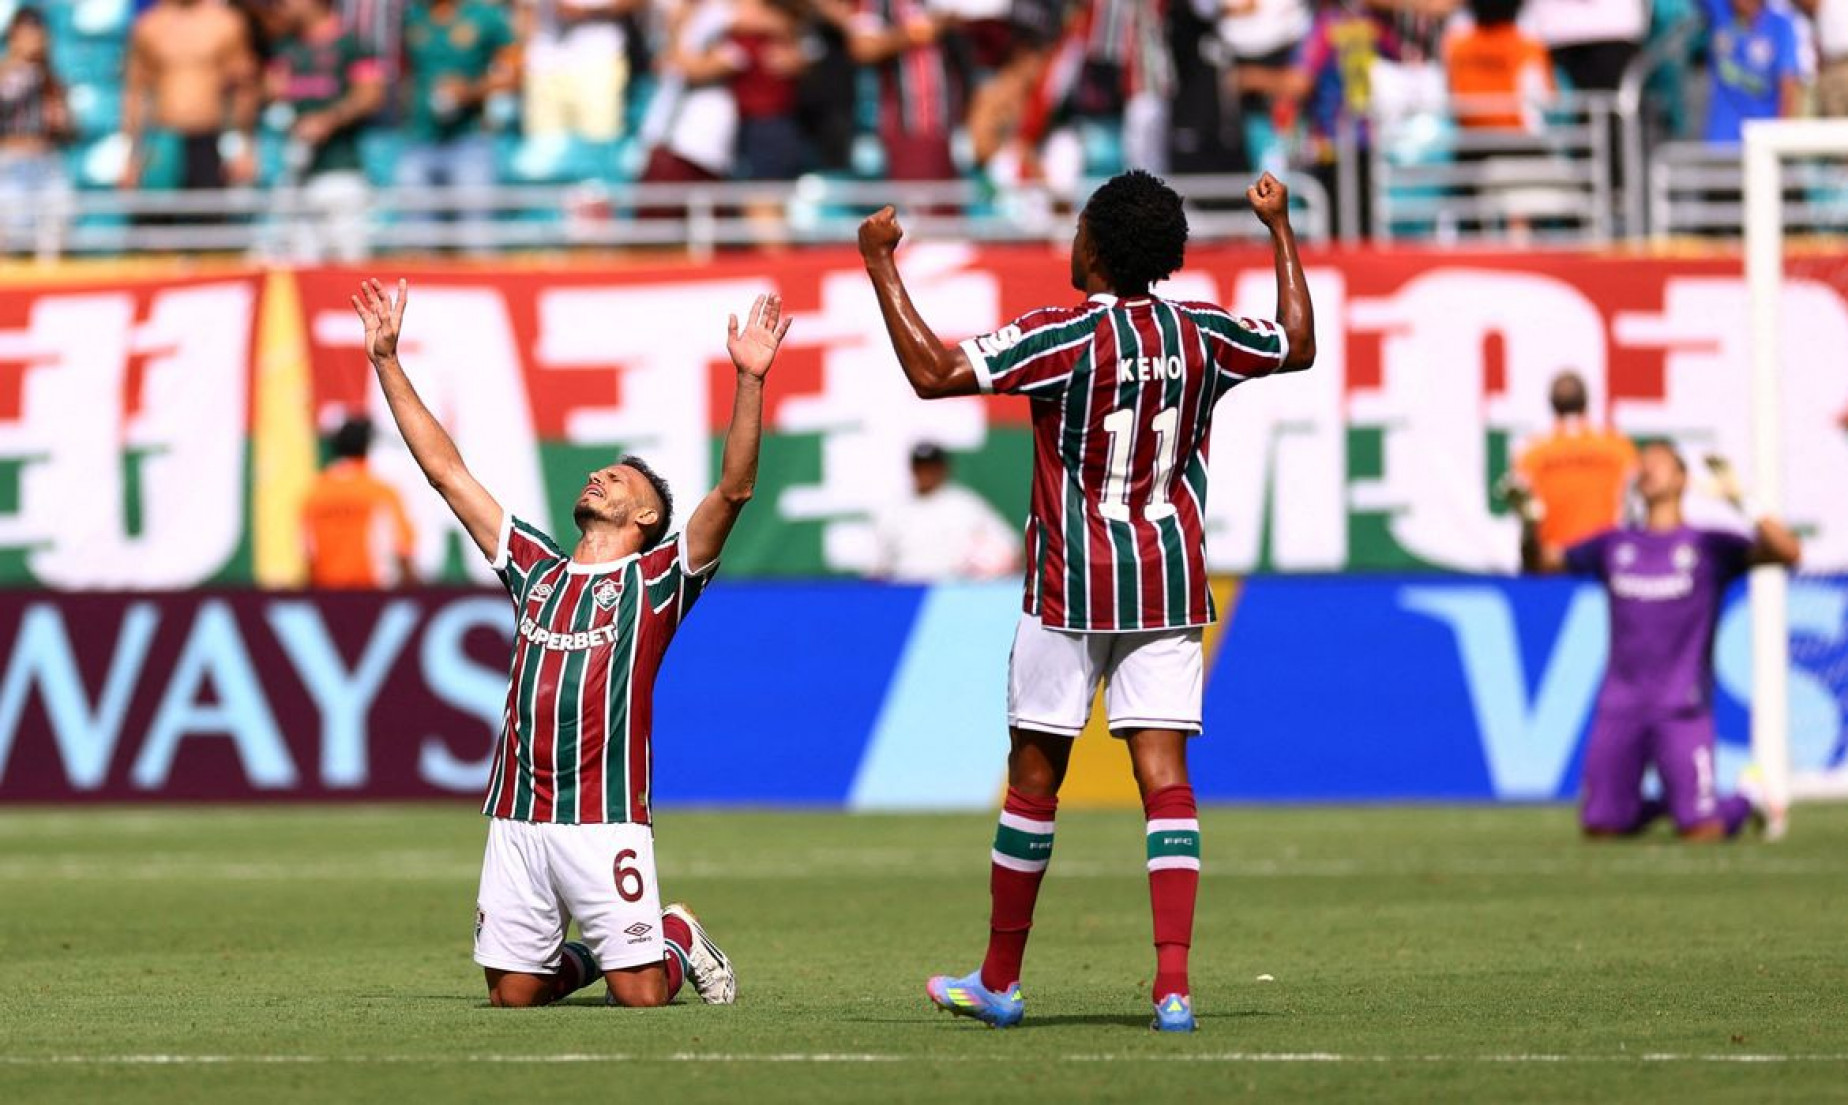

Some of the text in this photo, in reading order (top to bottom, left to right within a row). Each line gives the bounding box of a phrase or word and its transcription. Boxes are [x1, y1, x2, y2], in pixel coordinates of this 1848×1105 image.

[1120, 355, 1182, 382] KENO
[1098, 406, 1178, 522] 11
[520, 617, 617, 651] SUPERBET
[1398, 585, 1844, 798] VS
[613, 848, 644, 903] 6
